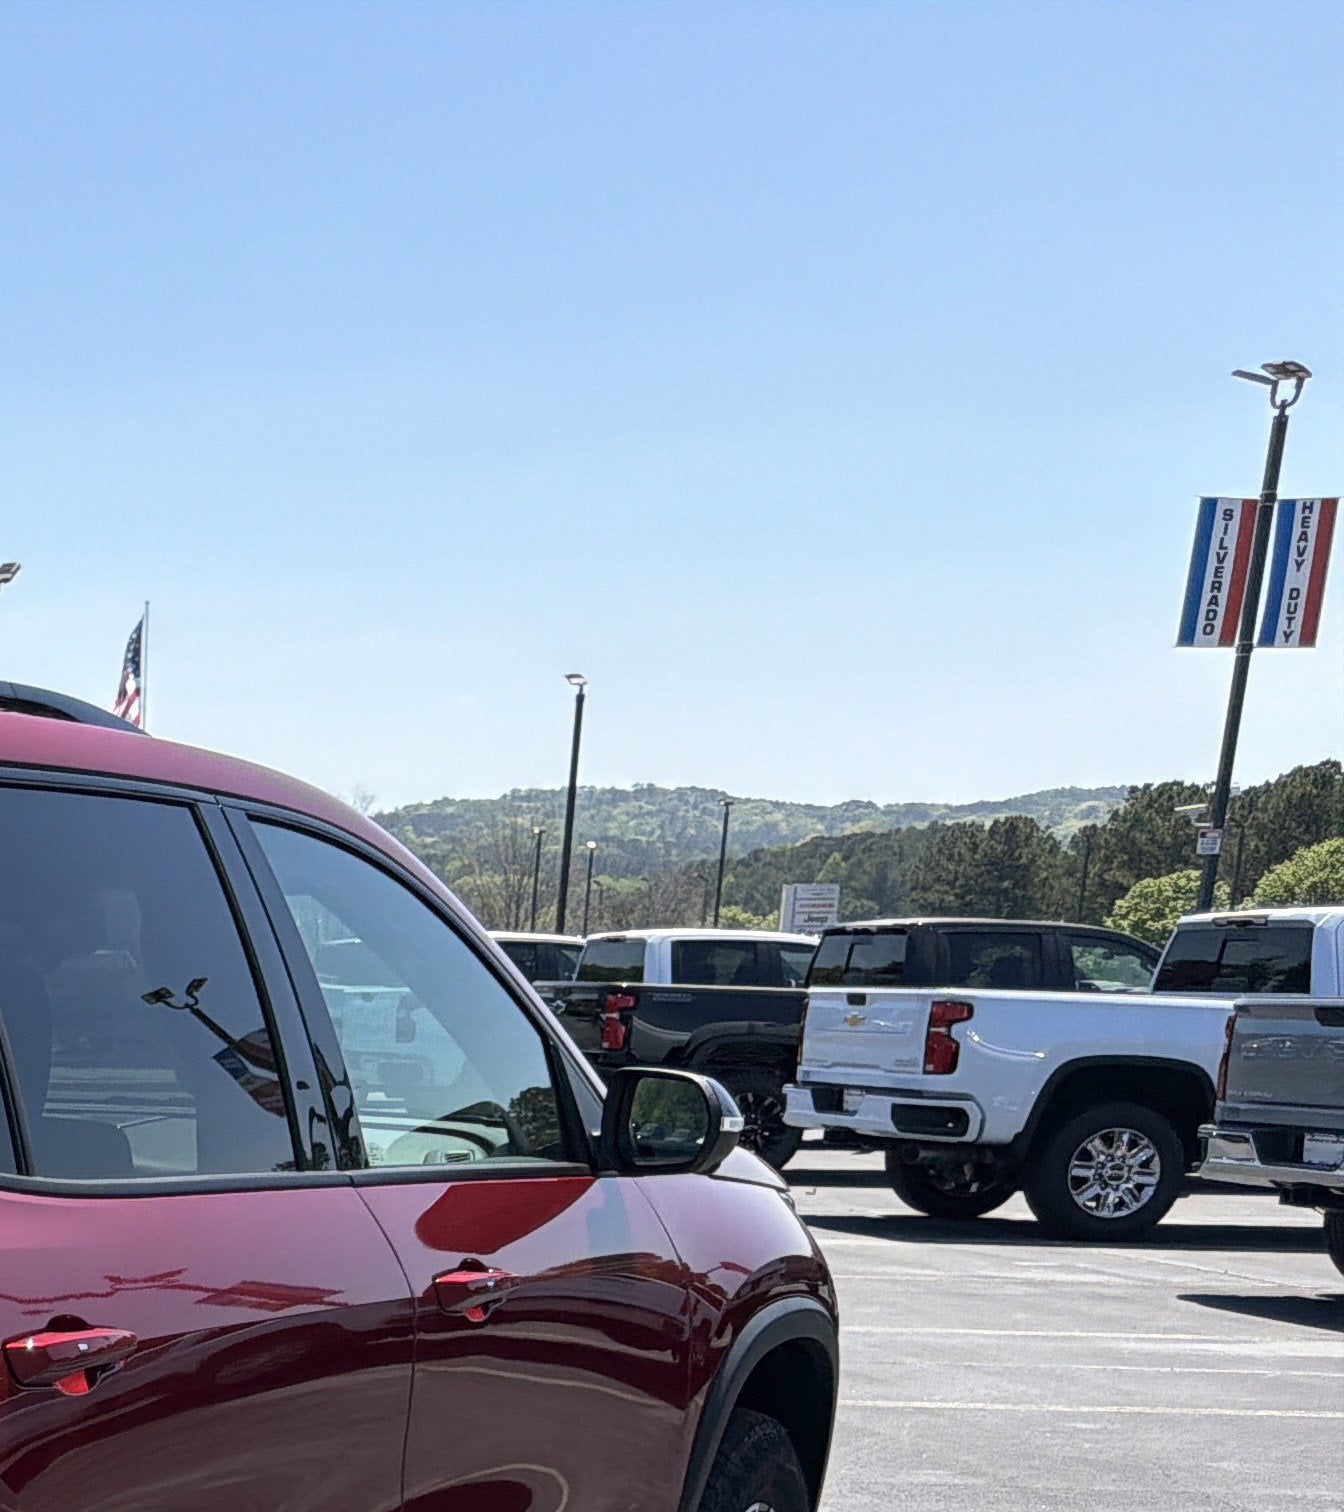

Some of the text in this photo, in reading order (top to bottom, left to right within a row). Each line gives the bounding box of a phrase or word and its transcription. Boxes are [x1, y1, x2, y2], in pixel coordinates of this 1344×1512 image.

[1202, 508, 1234, 636] SILVERADO
[1282, 501, 1315, 643] HEAVY DUTY
